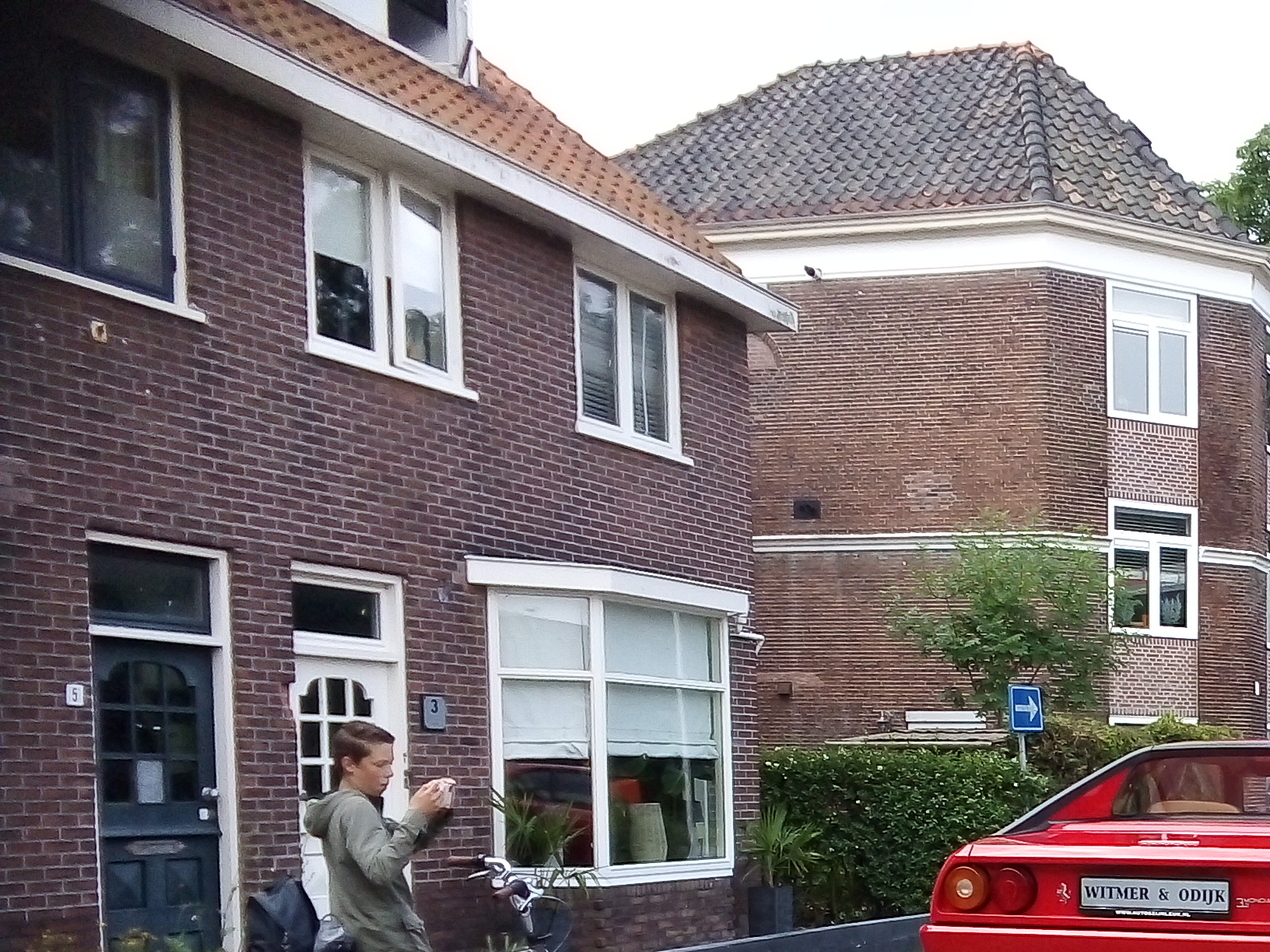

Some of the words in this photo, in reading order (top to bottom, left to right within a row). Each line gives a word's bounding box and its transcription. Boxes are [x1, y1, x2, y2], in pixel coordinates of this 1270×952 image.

[72, 687, 78, 702] 5
[430, 699, 439, 714] 3
[1084, 885, 1150, 901] WITMER
[1158, 887, 1170, 902] &
[1179, 888, 1226, 906] ODIJK
